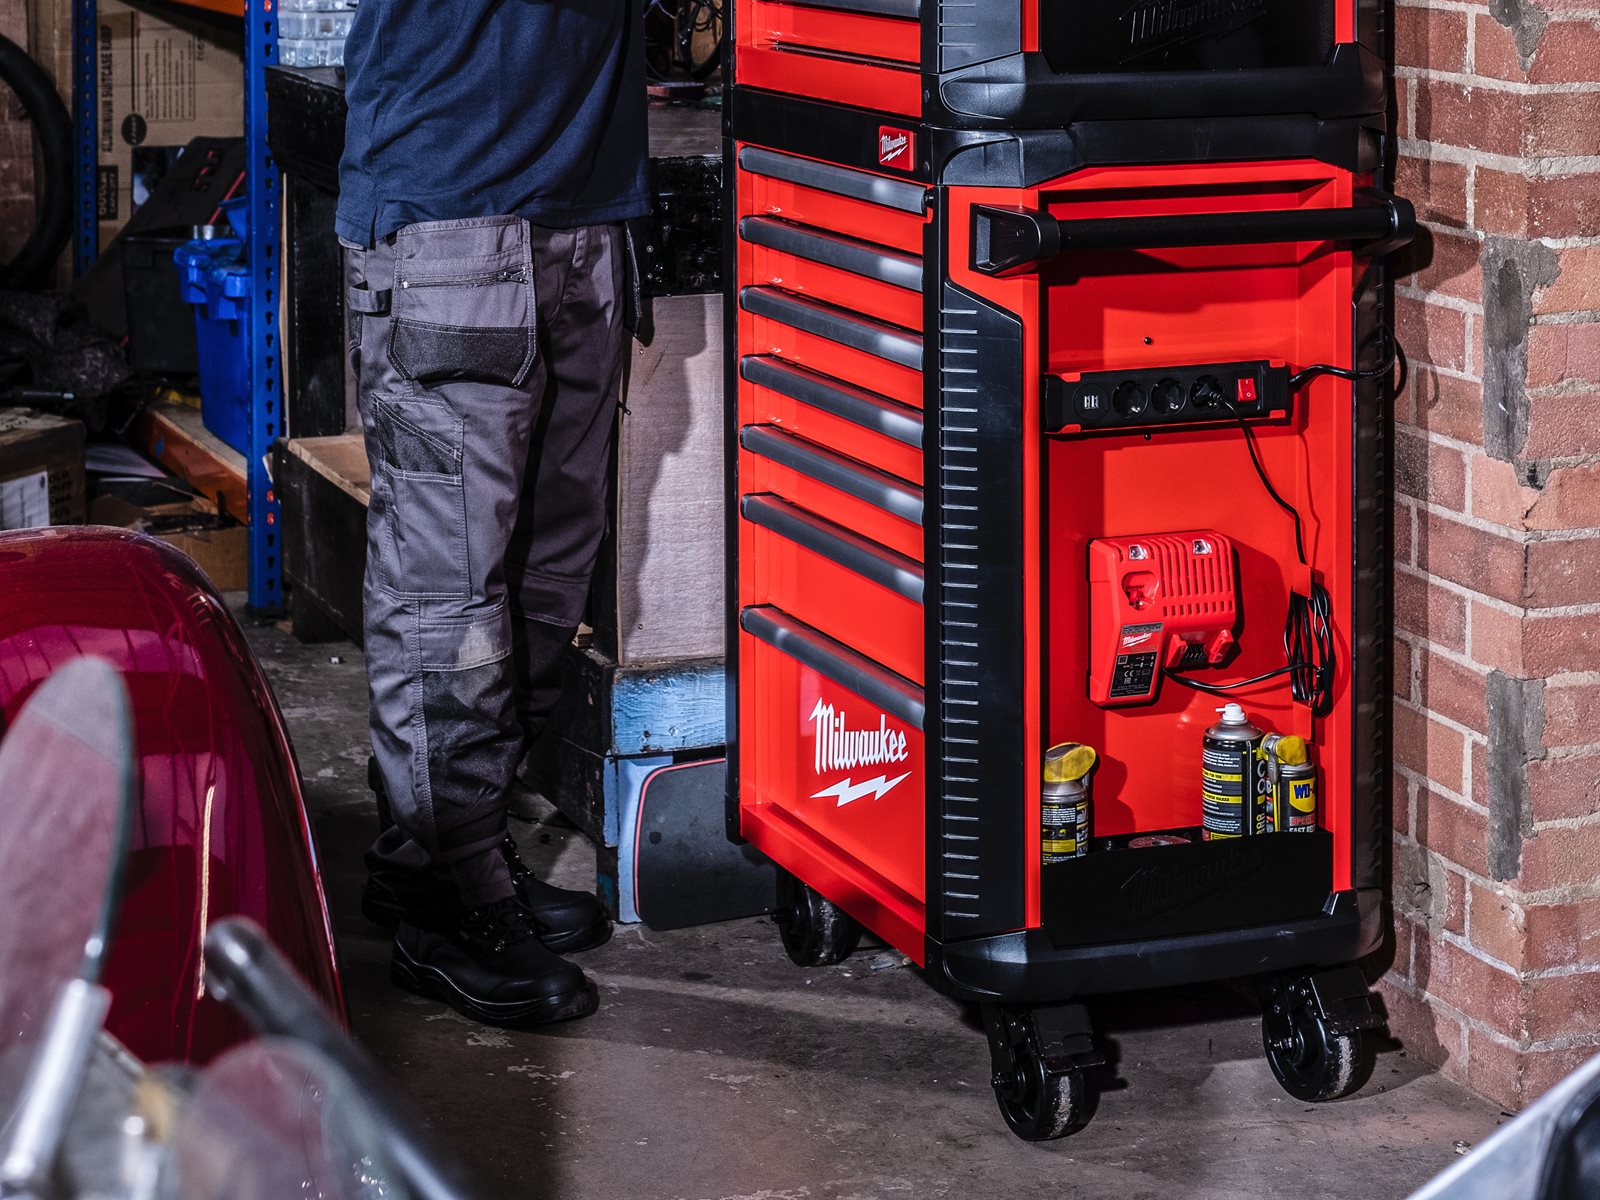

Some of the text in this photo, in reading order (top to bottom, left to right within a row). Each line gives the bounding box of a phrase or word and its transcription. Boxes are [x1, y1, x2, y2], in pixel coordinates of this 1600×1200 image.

[880, 133, 907, 155] Milwaukee
[808, 696, 909, 775] Milwaukee
[1293, 783, 1315, 800] WD-
